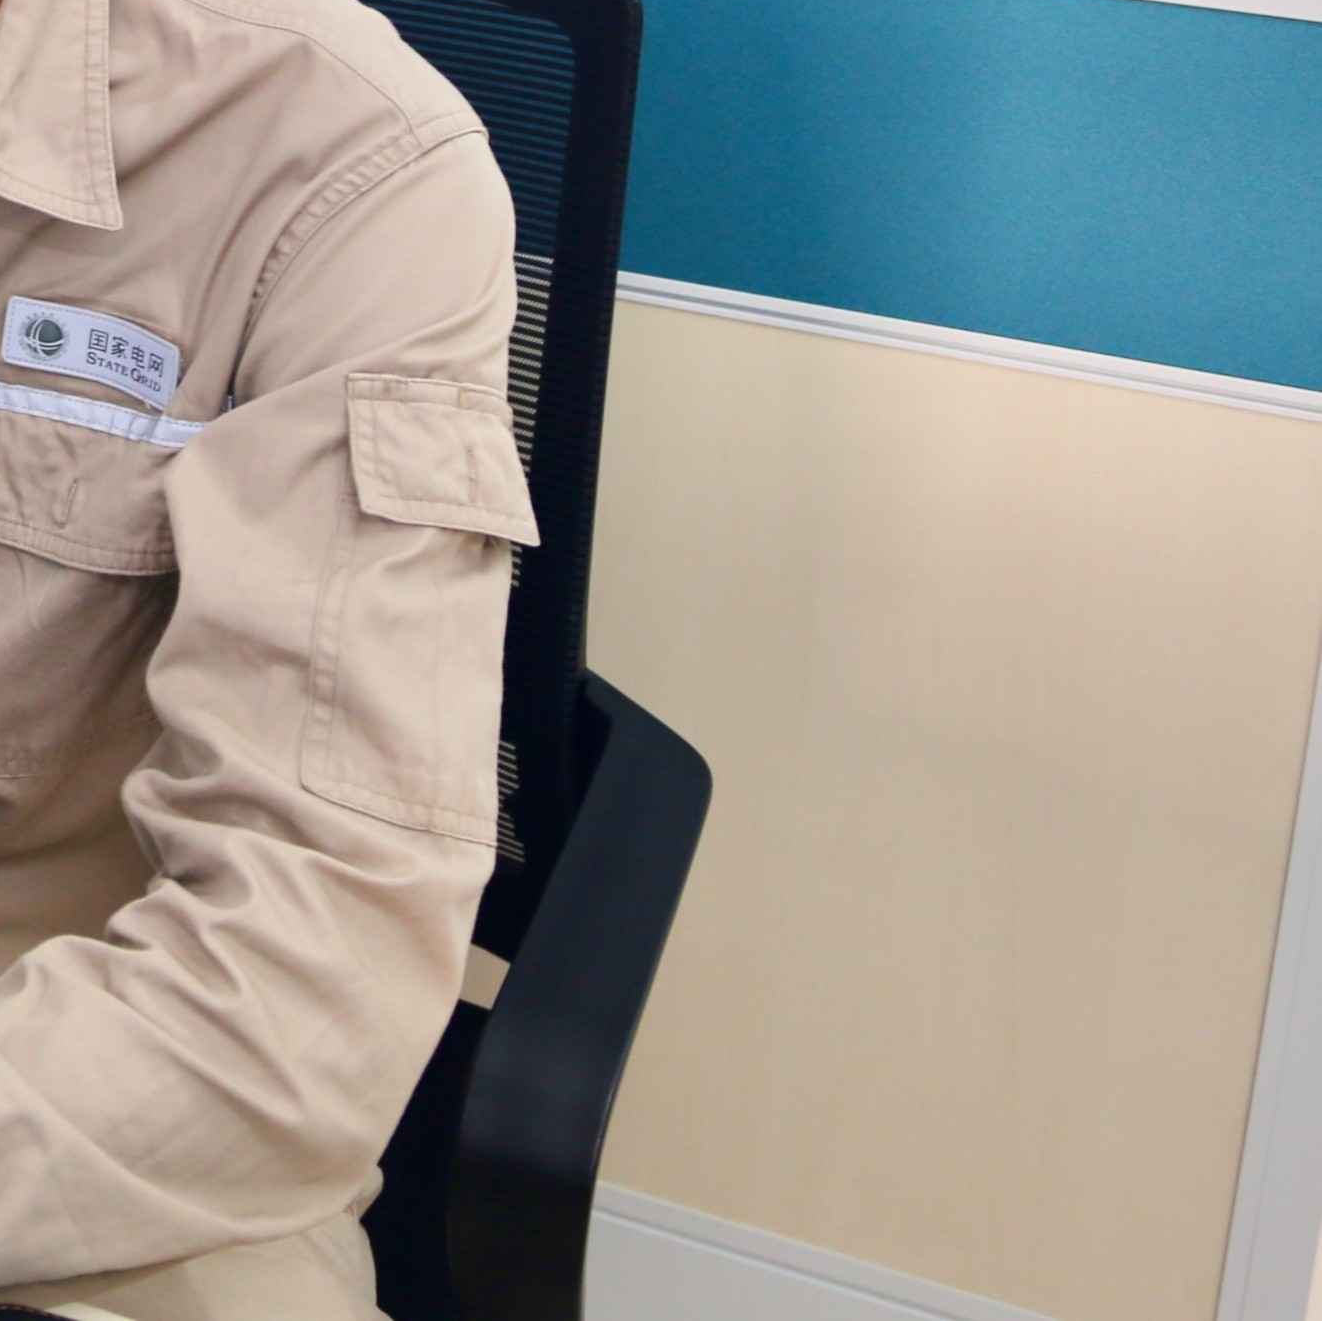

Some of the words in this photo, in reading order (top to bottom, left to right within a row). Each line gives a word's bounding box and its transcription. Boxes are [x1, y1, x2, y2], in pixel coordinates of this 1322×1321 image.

[86, 351, 128, 376] STATE
[130, 367, 161, 392] GRID
[88, 328, 165, 378] 国家电网
